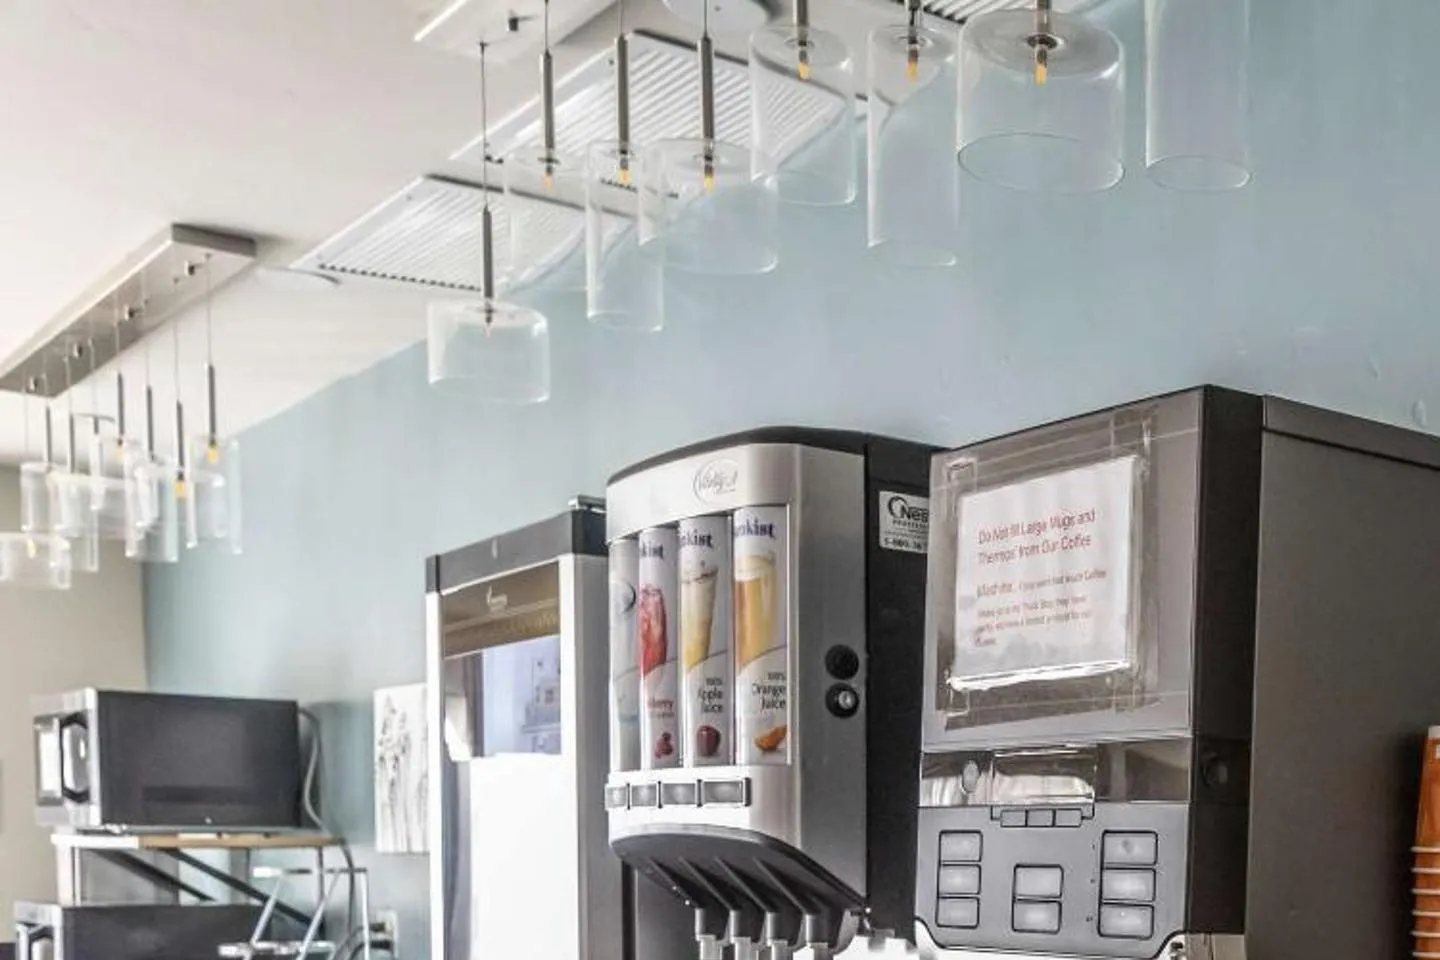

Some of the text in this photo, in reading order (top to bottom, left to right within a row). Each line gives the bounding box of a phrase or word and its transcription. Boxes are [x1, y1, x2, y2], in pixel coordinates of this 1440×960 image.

[1021, 521, 1047, 536] Large
[1076, 508, 1096, 524] and
[1060, 534, 1092, 550] Coffee
[751, 682, 787, 698] Orange
[760, 698, 786, 712] Juice
